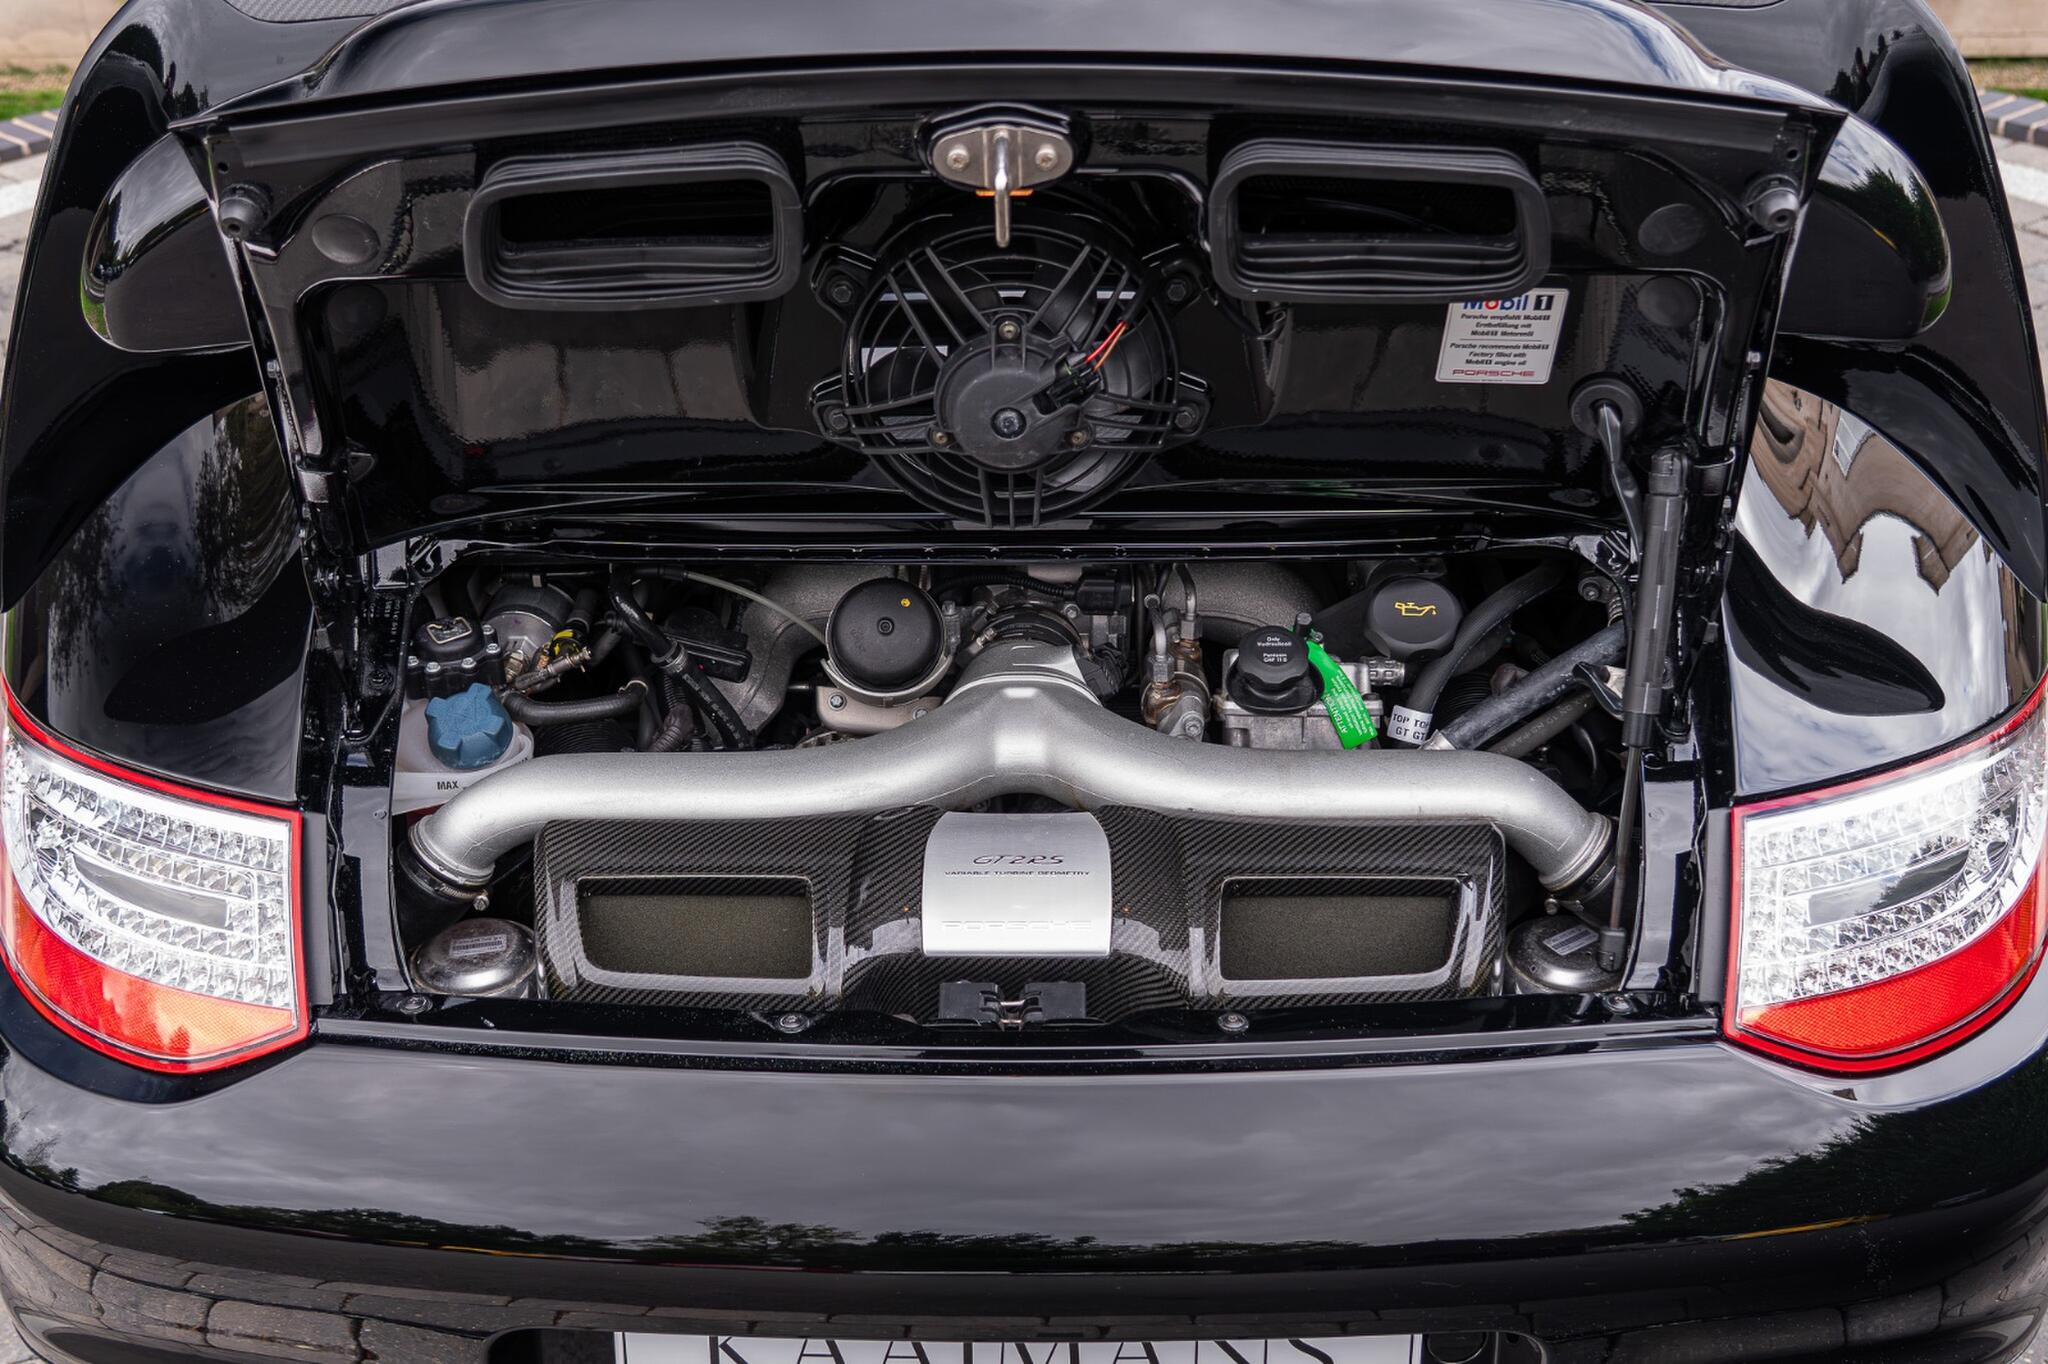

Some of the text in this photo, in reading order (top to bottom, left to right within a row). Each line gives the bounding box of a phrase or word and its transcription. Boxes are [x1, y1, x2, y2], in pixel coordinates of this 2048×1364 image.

[1463, 295, 1528, 310] Mobil
[1452, 369, 1535, 377] PORSCHE
[1395, 726, 1410, 737] GT
[437, 780, 459, 790] MAX
[942, 920, 1092, 930] PORSCHE
